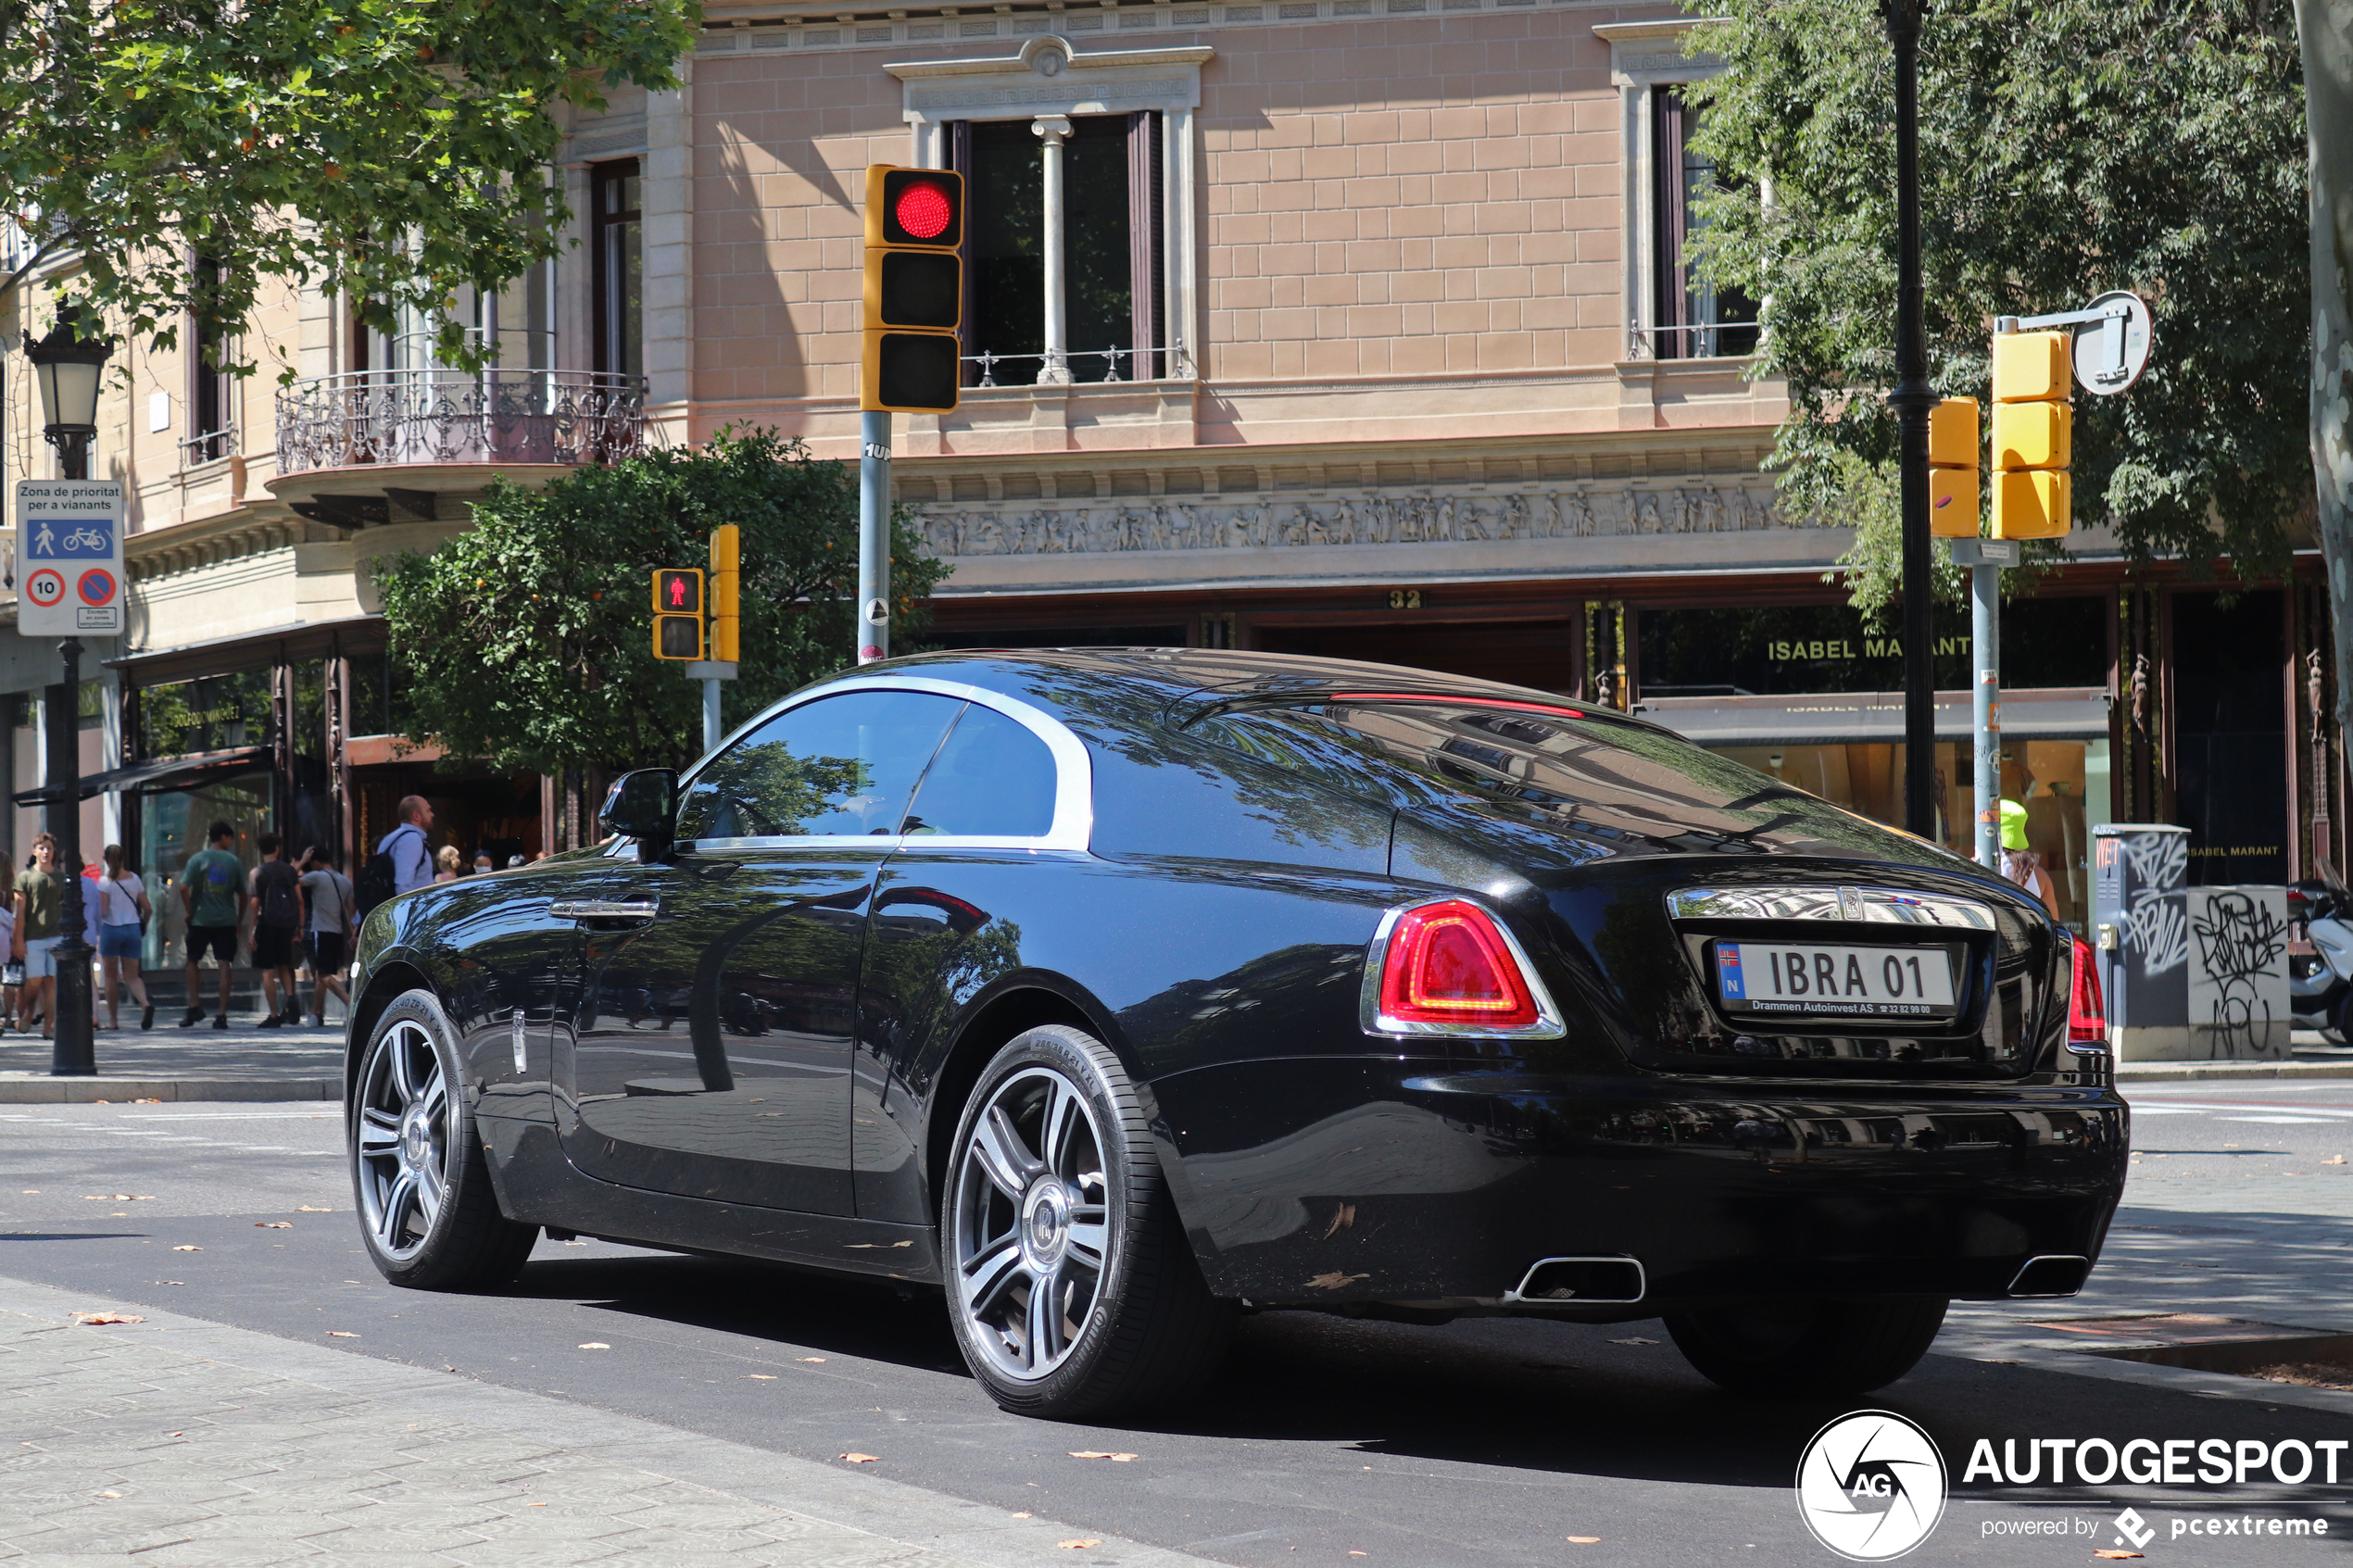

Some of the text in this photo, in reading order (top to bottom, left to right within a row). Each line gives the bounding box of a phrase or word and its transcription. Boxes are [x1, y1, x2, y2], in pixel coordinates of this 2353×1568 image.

[20, 486, 120, 499] Zona de prioritat
[28, 500, 111, 512] per a vianants
[37, 582, 56, 595] 10
[1390, 590, 1421, 609] 32
[1768, 636, 1971, 660] ISABEL MANT
[2095, 837, 2121, 872] WET
[2186, 846, 2279, 857] ISABEL MARANT
[1770, 952, 1924, 998] IBRA 01
[1727, 979, 1739, 994] N
[1752, 999, 1931, 1015] Drammen Autoinvest AS 32 82 99 00
[1063, 1048, 1071, 1059] R
[1070, 1056, 1079, 1067] 21
[1086, 1074, 1095, 1089] XL
